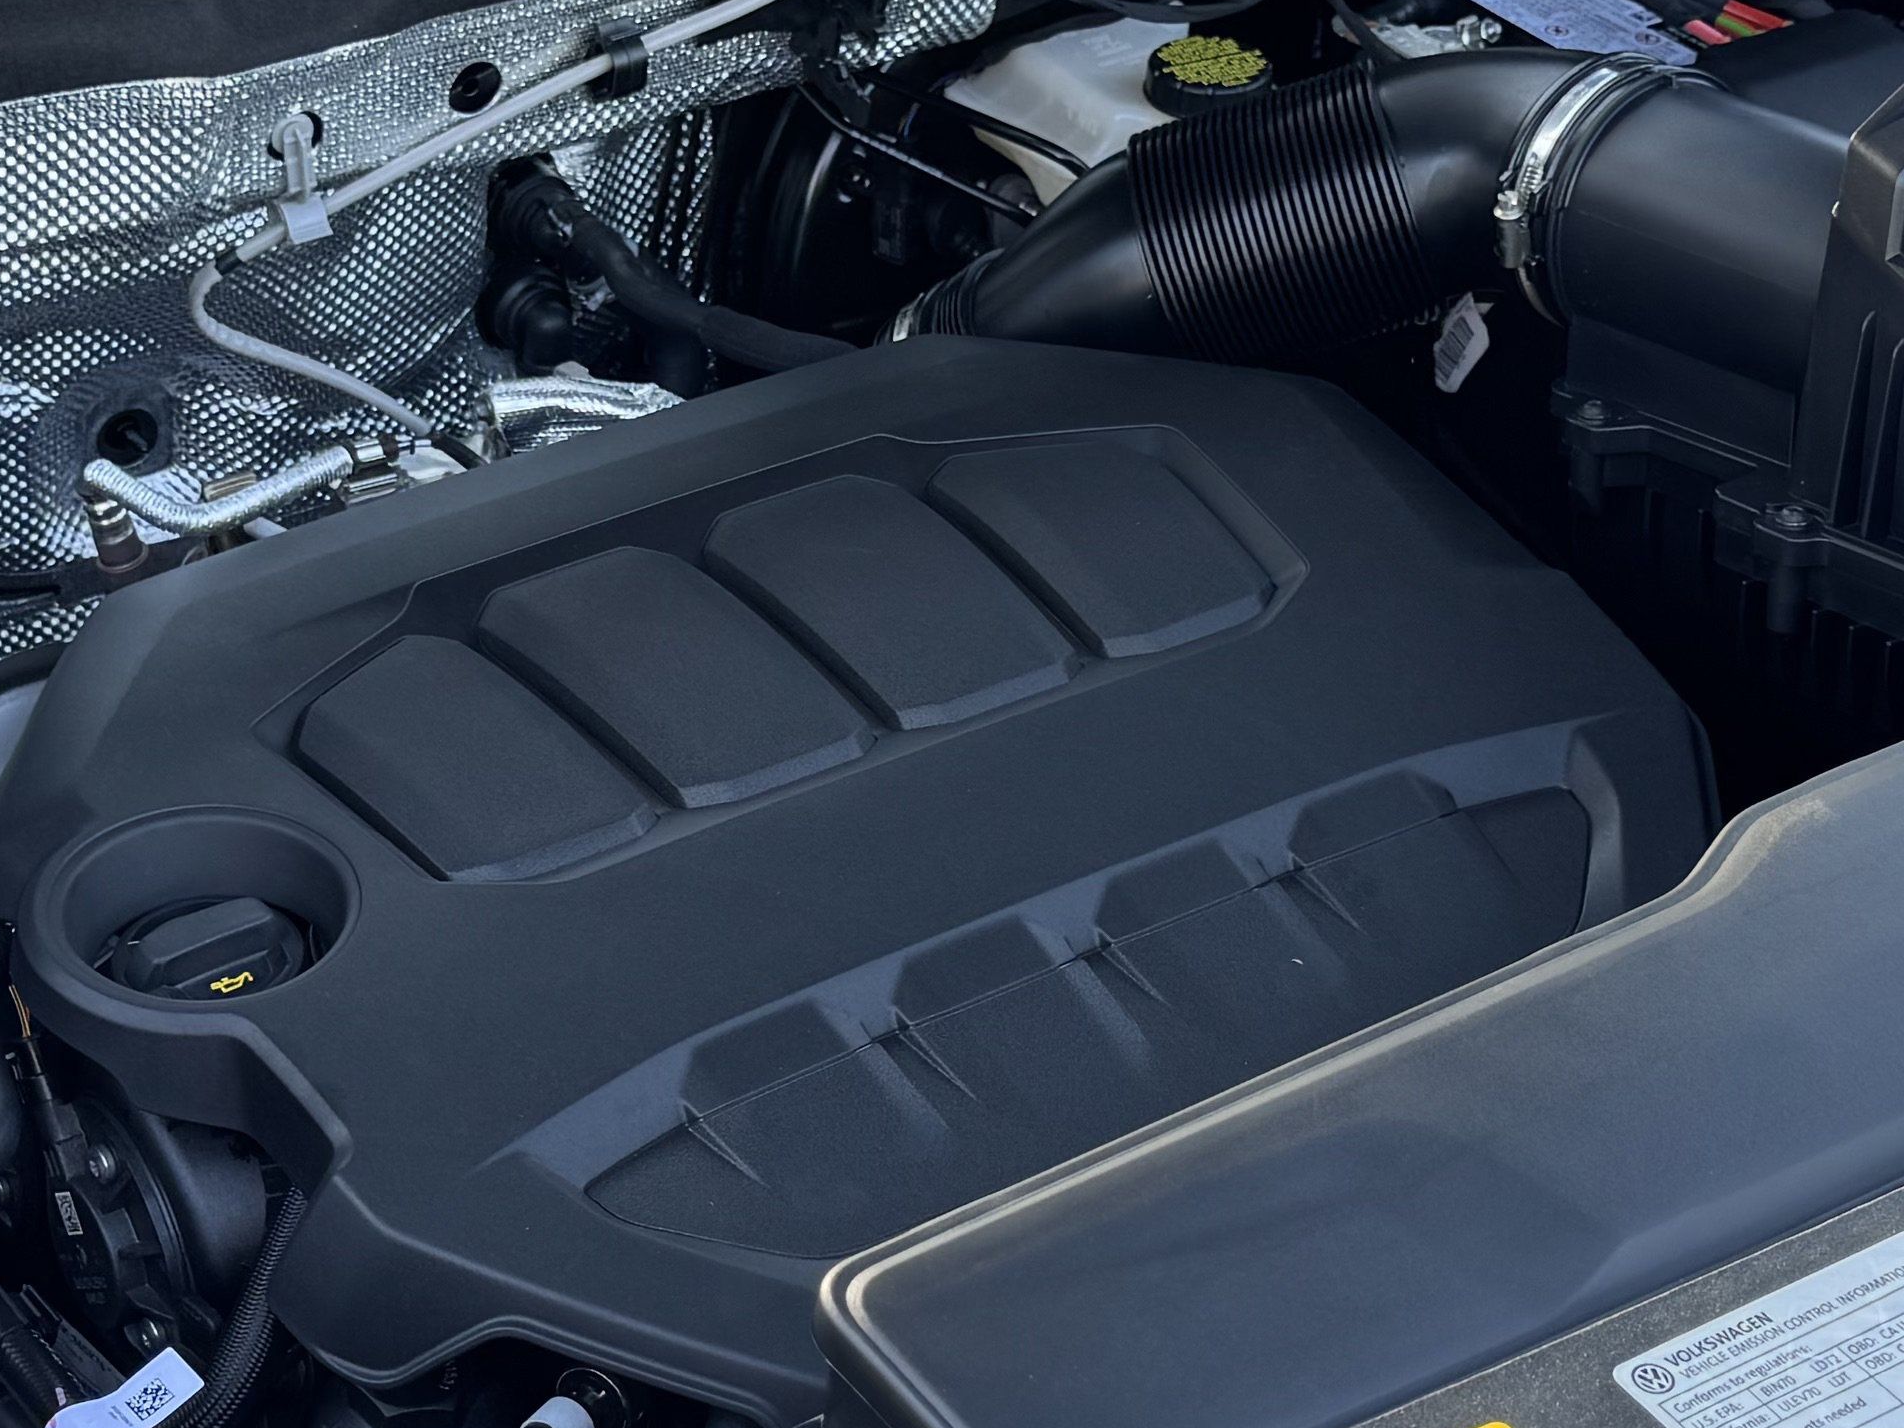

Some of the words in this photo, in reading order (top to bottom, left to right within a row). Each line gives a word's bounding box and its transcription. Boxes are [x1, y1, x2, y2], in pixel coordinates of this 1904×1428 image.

[1662, 1310, 1776, 1370] VOLKSWAGEN
[1677, 1350, 1732, 1381] VEHICLE
[1725, 1324, 1787, 1358] EMISSION
[1780, 1299, 1840, 1331] CONTROL
[1670, 1379, 1735, 1415] Conforms
[1727, 1373, 1749, 1388] to
[1713, 1399, 1747, 1420] EPA:
[1807, 1352, 1843, 1374] LDT2
[1843, 1334, 1881, 1356] OBD:
[1875, 1324, 1901, 1340] CA
[1775, 1385, 1825, 1413] ULEV70
[1825, 1370, 1855, 1388] LDT
[1861, 1348, 1899, 1371] OBD:
[1819, 1395, 1869, 1424] needed
